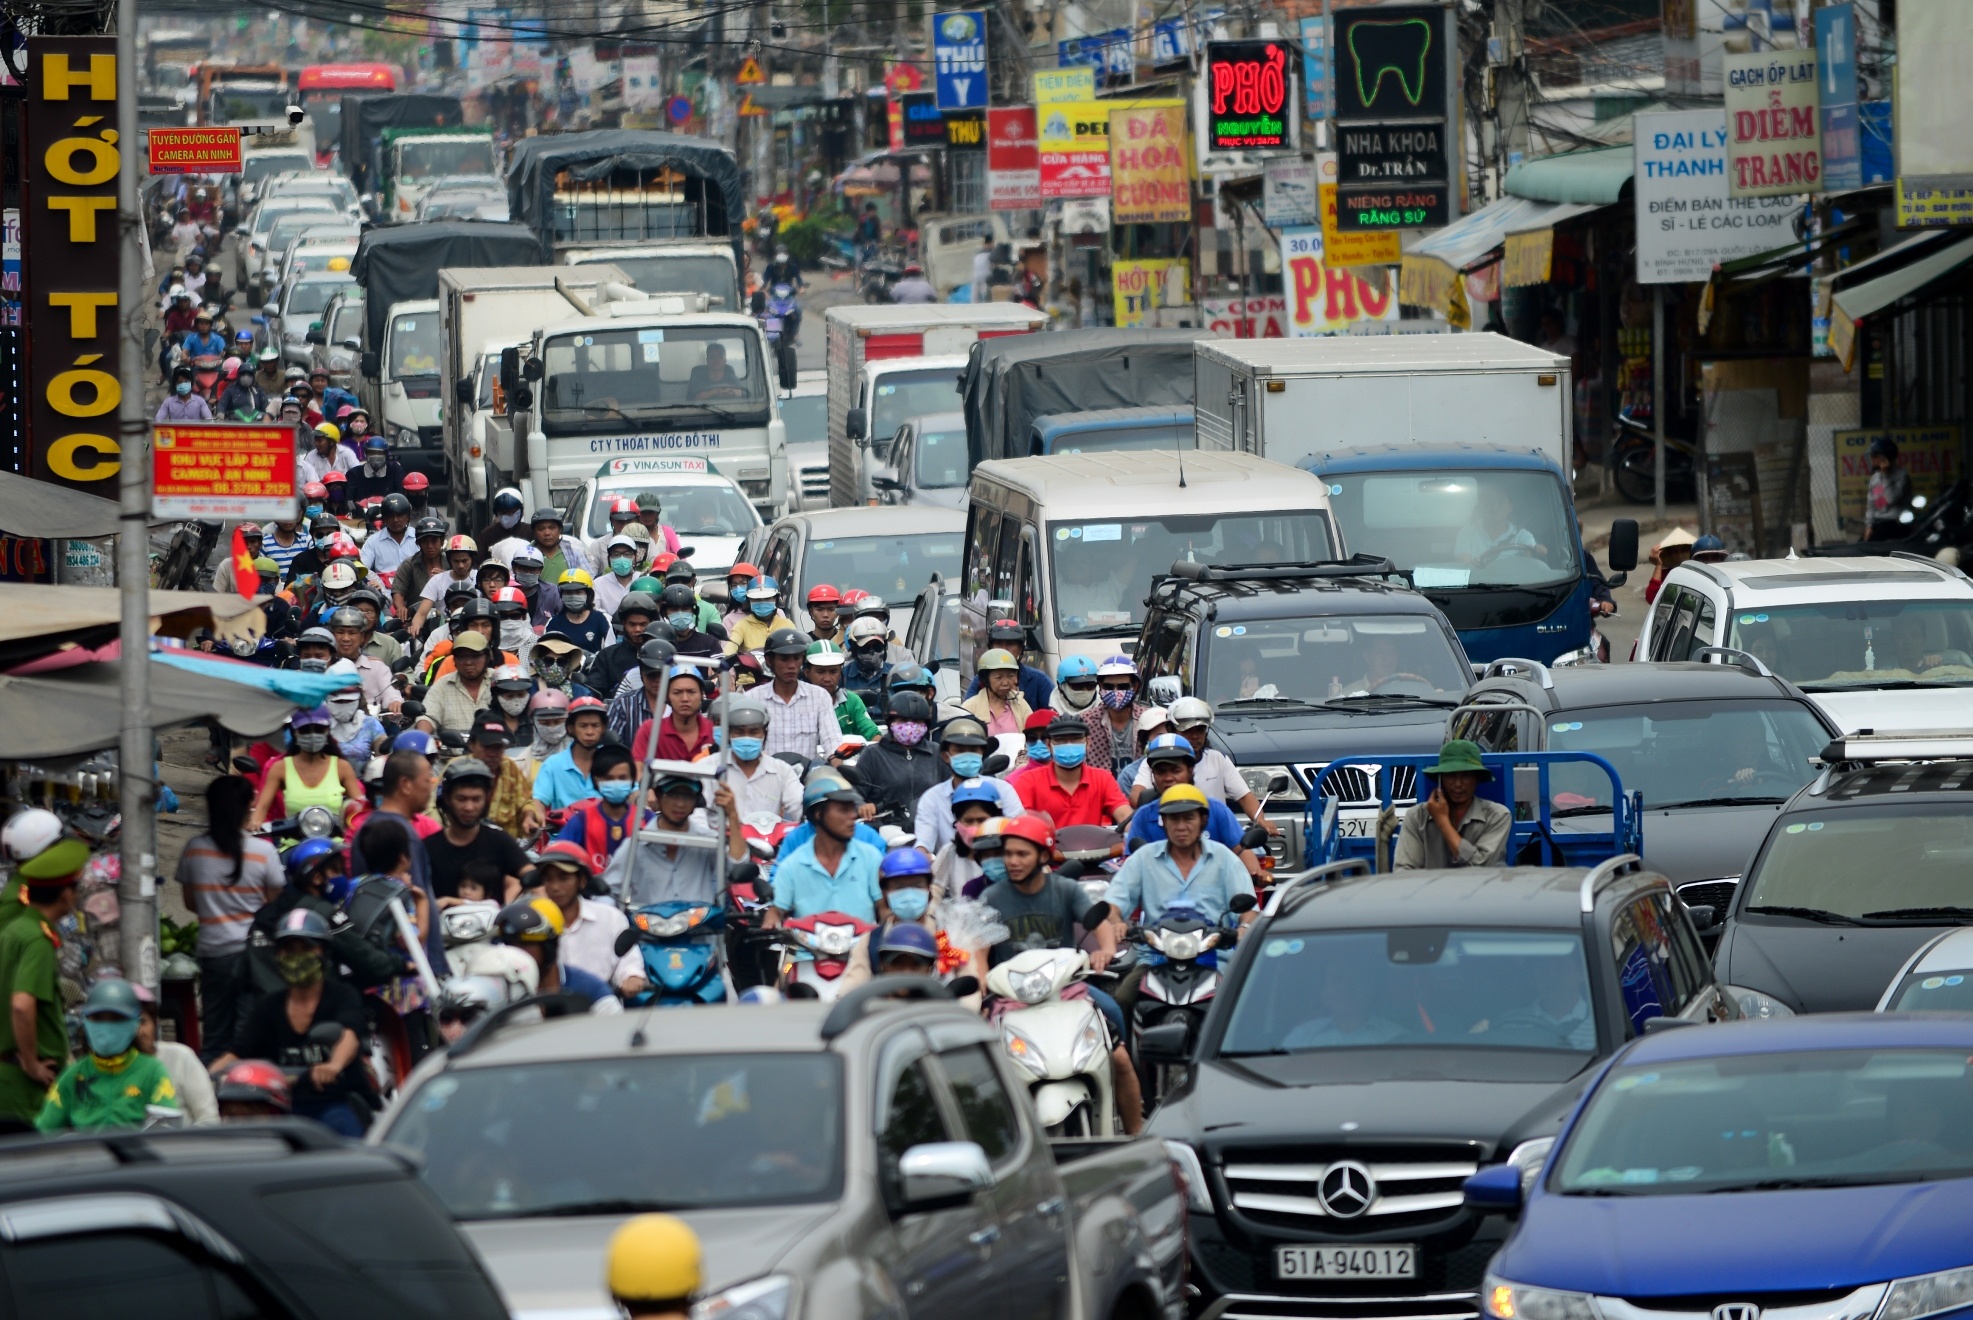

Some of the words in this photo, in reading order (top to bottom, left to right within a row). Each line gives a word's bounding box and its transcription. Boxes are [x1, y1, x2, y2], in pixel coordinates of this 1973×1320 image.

[936, 38, 985, 74] THÚ
[1212, 44, 1285, 114] PHỞ
[1730, 69, 1764, 91] GẠCH
[1768, 60, 1786, 86] ỐP
[1790, 60, 1814, 83] LÁT
[953, 79, 971, 105] Y
[1128, 112, 1168, 140] ĐÁ
[1736, 90, 1815, 142] DIỄM
[43, 54, 121, 243] HỚT
[152, 132, 180, 145] TUYẾN
[182, 132, 215, 144] ĐƯỜNG
[1346, 134, 1383, 154] NHA
[1389, 131, 1438, 152] KHOA
[1654, 132, 1694, 152] ĐẠI
[1702, 127, 1727, 148] LÝ
[158, 150, 194, 160] CAMERA
[196, 150, 208, 159] AN
[211, 150, 233, 159] NINH
[1118, 146, 1182, 170] HOA
[1644, 159, 1724, 178] THANH
[1735, 151, 1819, 188] TRANG
[1359, 208, 1401, 224] RĂNG
[1404, 208, 1427, 224] SỨ
[1711, 213, 1743, 228] CÁC
[1747, 215, 1781, 229] LOẠI
[46, 292, 122, 482] TÓC
[685, 432, 699, 447] ĐÔ
[702, 434, 720, 448] THỊ
[170, 467, 221, 480] CAMERA
[224, 468, 242, 480] AN
[243, 468, 271, 480] NINH
[633, 461, 682, 470] VINASUN
[683, 460, 705, 470] TAXI
[1284, 1250, 1411, 1275] 51A-940.12
